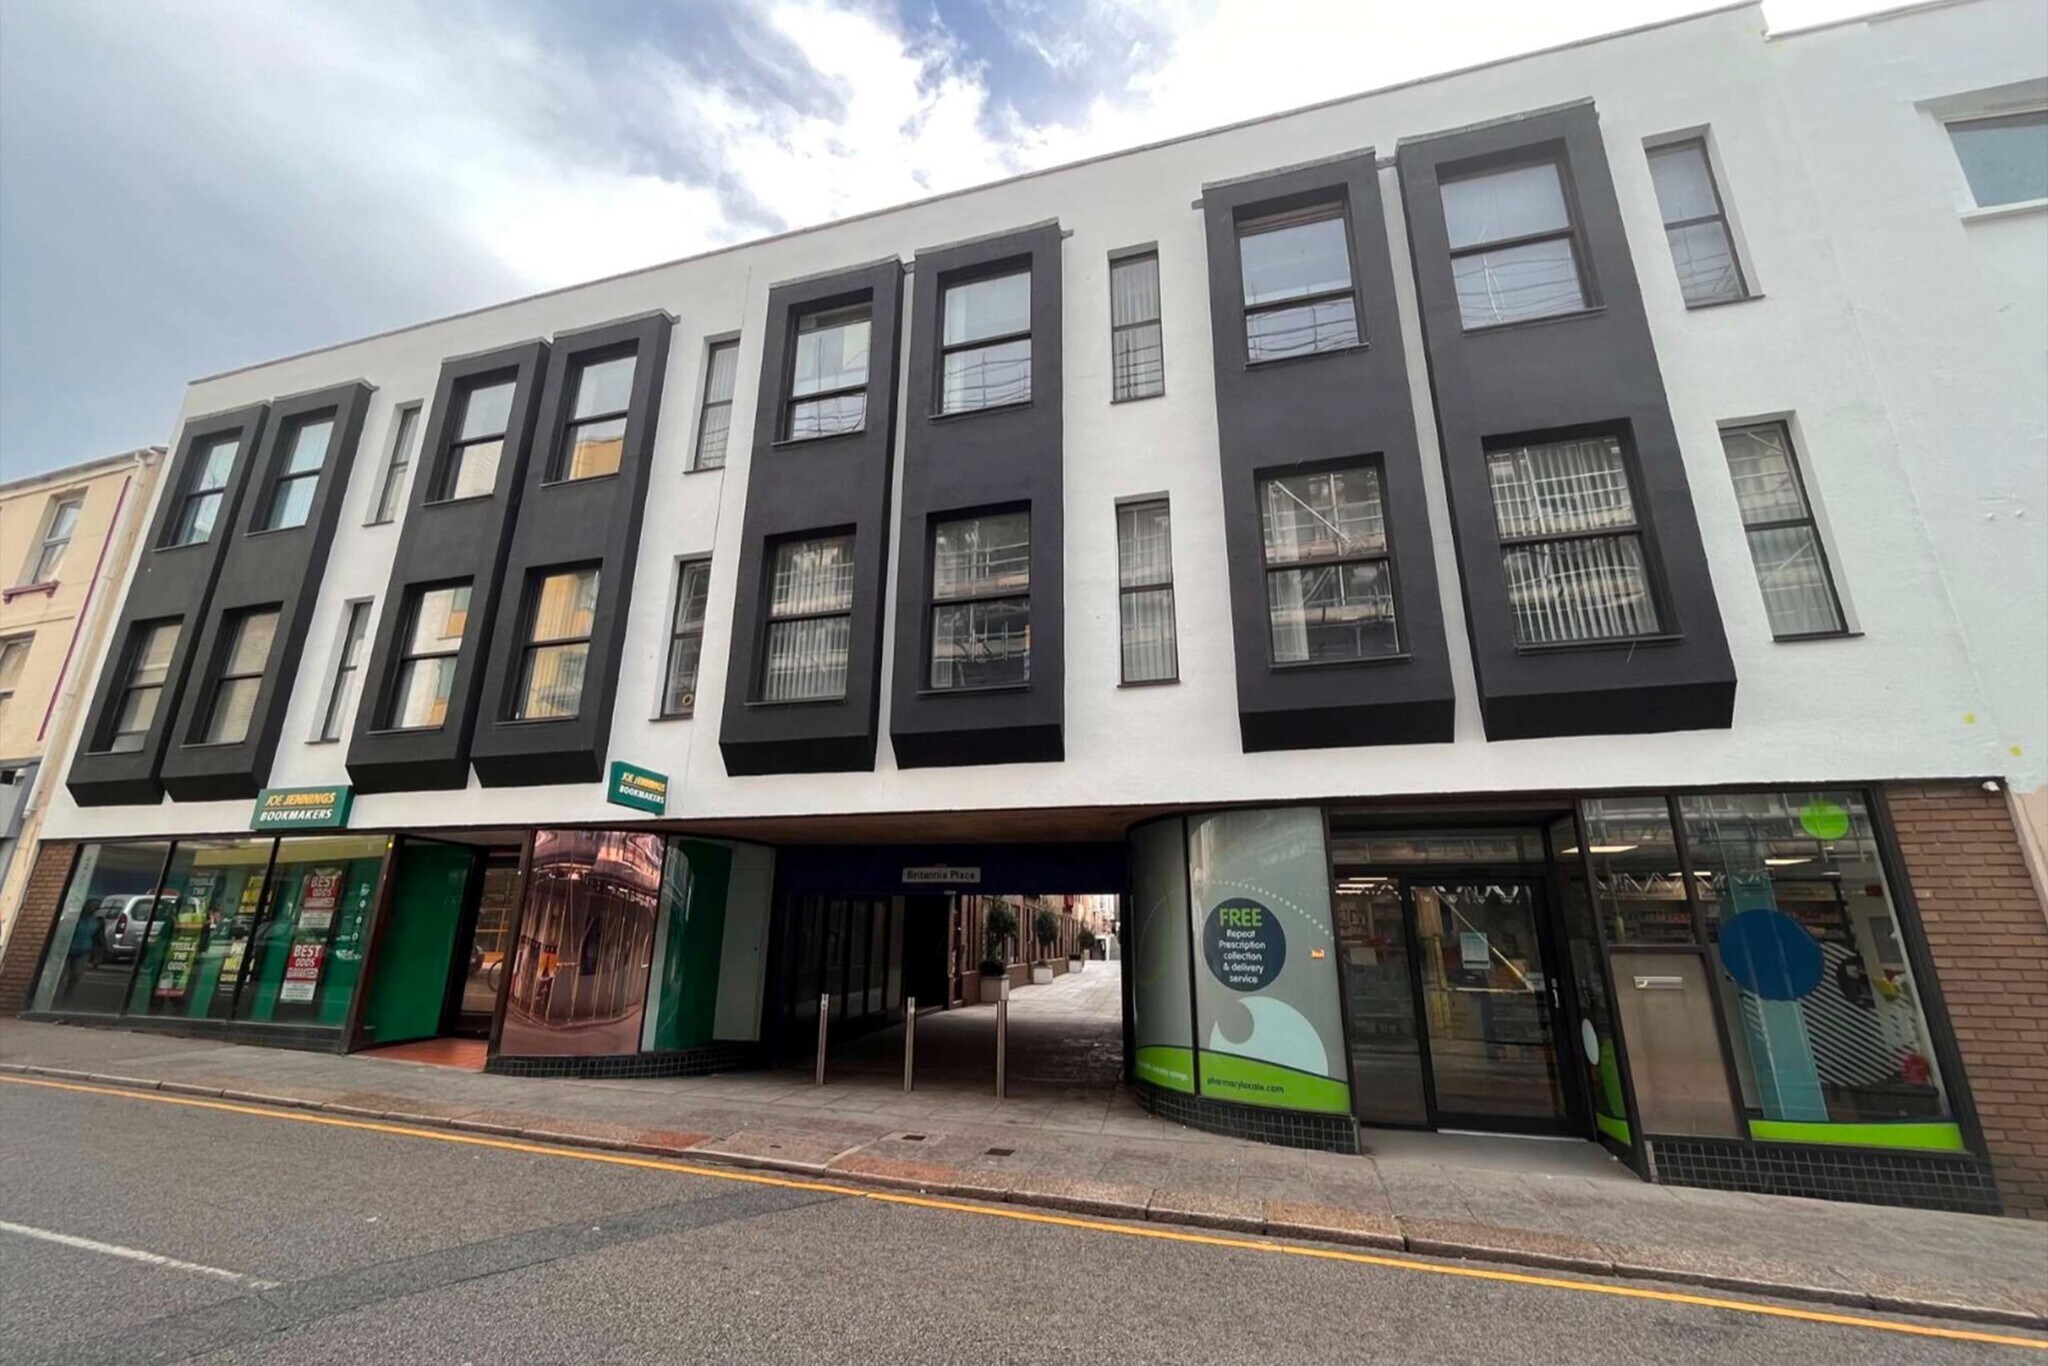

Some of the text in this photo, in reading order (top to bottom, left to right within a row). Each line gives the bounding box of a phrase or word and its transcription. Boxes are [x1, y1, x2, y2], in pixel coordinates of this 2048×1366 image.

[265, 792, 337, 807] JOE JENNINGS
[619, 785, 665, 804] BOOKMAKERS
[260, 809, 333, 822] BOOKMAKERS
[950, 869, 976, 880] Place
[311, 875, 339, 888] BEST
[1219, 908, 1263, 927] FREE
[1226, 929, 1256, 940] Repeat
[294, 944, 323, 957] BEST
[1218, 940, 1267, 951] Prescription
[173, 952, 189, 961] THE
[1223, 951, 1263, 961] collection
[295, 957, 316, 967] ODDS
[1223, 962, 1264, 974] & delivery
[1229, 973, 1259, 984] service
